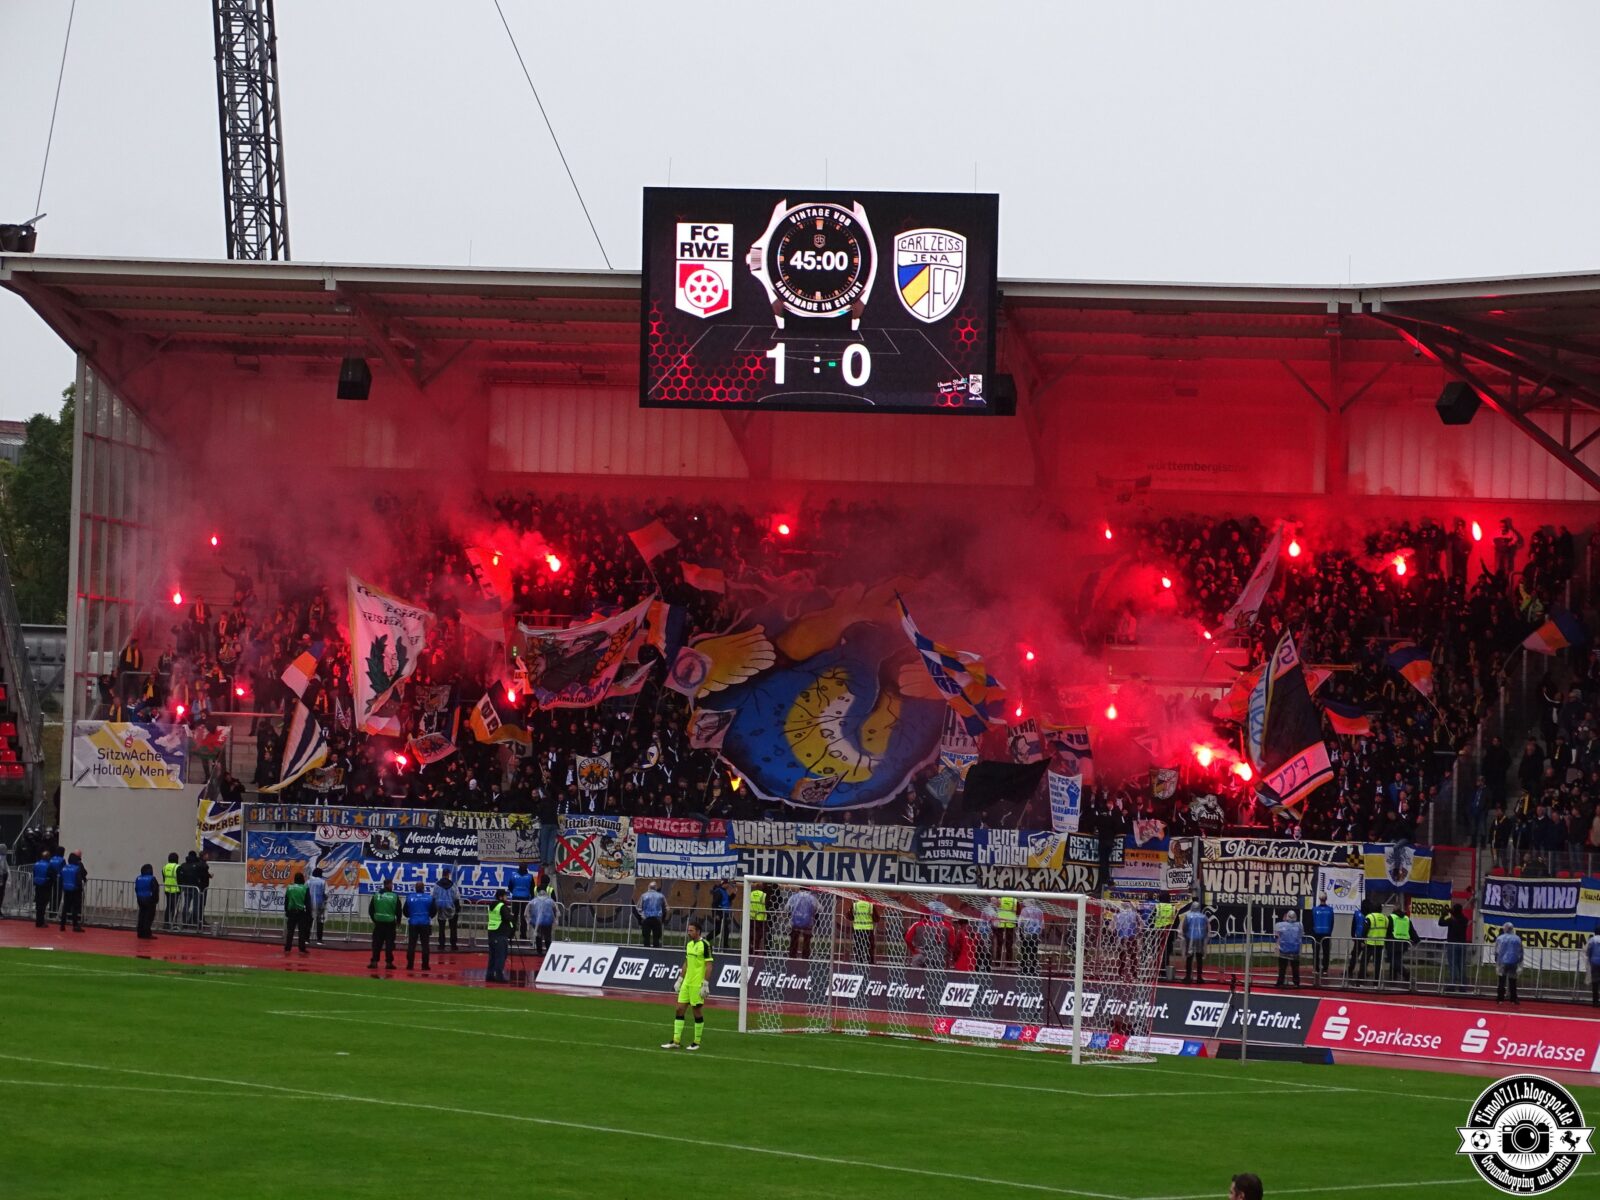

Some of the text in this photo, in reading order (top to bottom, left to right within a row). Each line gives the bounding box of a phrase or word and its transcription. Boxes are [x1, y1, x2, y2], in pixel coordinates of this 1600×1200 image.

[789, 208, 830, 224] VINTAGE
[690, 226, 719, 241] FC
[901, 236, 960, 250] CARL ZEISS
[680, 242, 730, 259] RWE
[789, 250, 848, 270] 45:00
[910, 254, 950, 263] JENA
[775, 280, 863, 311] HANDMADE IN ERFURT
[932, 267, 958, 312] FC
[766, 342, 785, 384] 1
[841, 344, 872, 386] 0
[97, 748, 162, 762] SitzwAche
[93, 764, 164, 778] HolidAy Men
[368, 813, 398, 827] MIT
[443, 815, 512, 830] WEIMAR
[260, 836, 288, 858] Fan
[649, 837, 725, 855] UNBEUGSAM
[1224, 840, 1343, 866] Rockendorf
[262, 862, 291, 880] Club
[902, 864, 977, 884] ULTRAS
[1203, 868, 1314, 896] WOLFPACK
[1216, 892, 1298, 906] FCC SUPPORTERS
[1532, 886, 1578, 910] MIND
[544, 954, 609, 975] NT.AG
[618, 961, 642, 976] SWE
[650, 964, 670, 978] Für
[755, 972, 776, 987] Für
[832, 978, 860, 994] SWE
[866, 980, 886, 998] Für
[945, 986, 976, 1004] SWE
[982, 990, 1003, 1006] Für
[1103, 1000, 1126, 1017] Für
[1191, 1004, 1302, 1030] SWE Für Erfurt.
[1354, 1025, 1442, 1050] Sparkasse
[1493, 1036, 1586, 1062] Sparkasse
